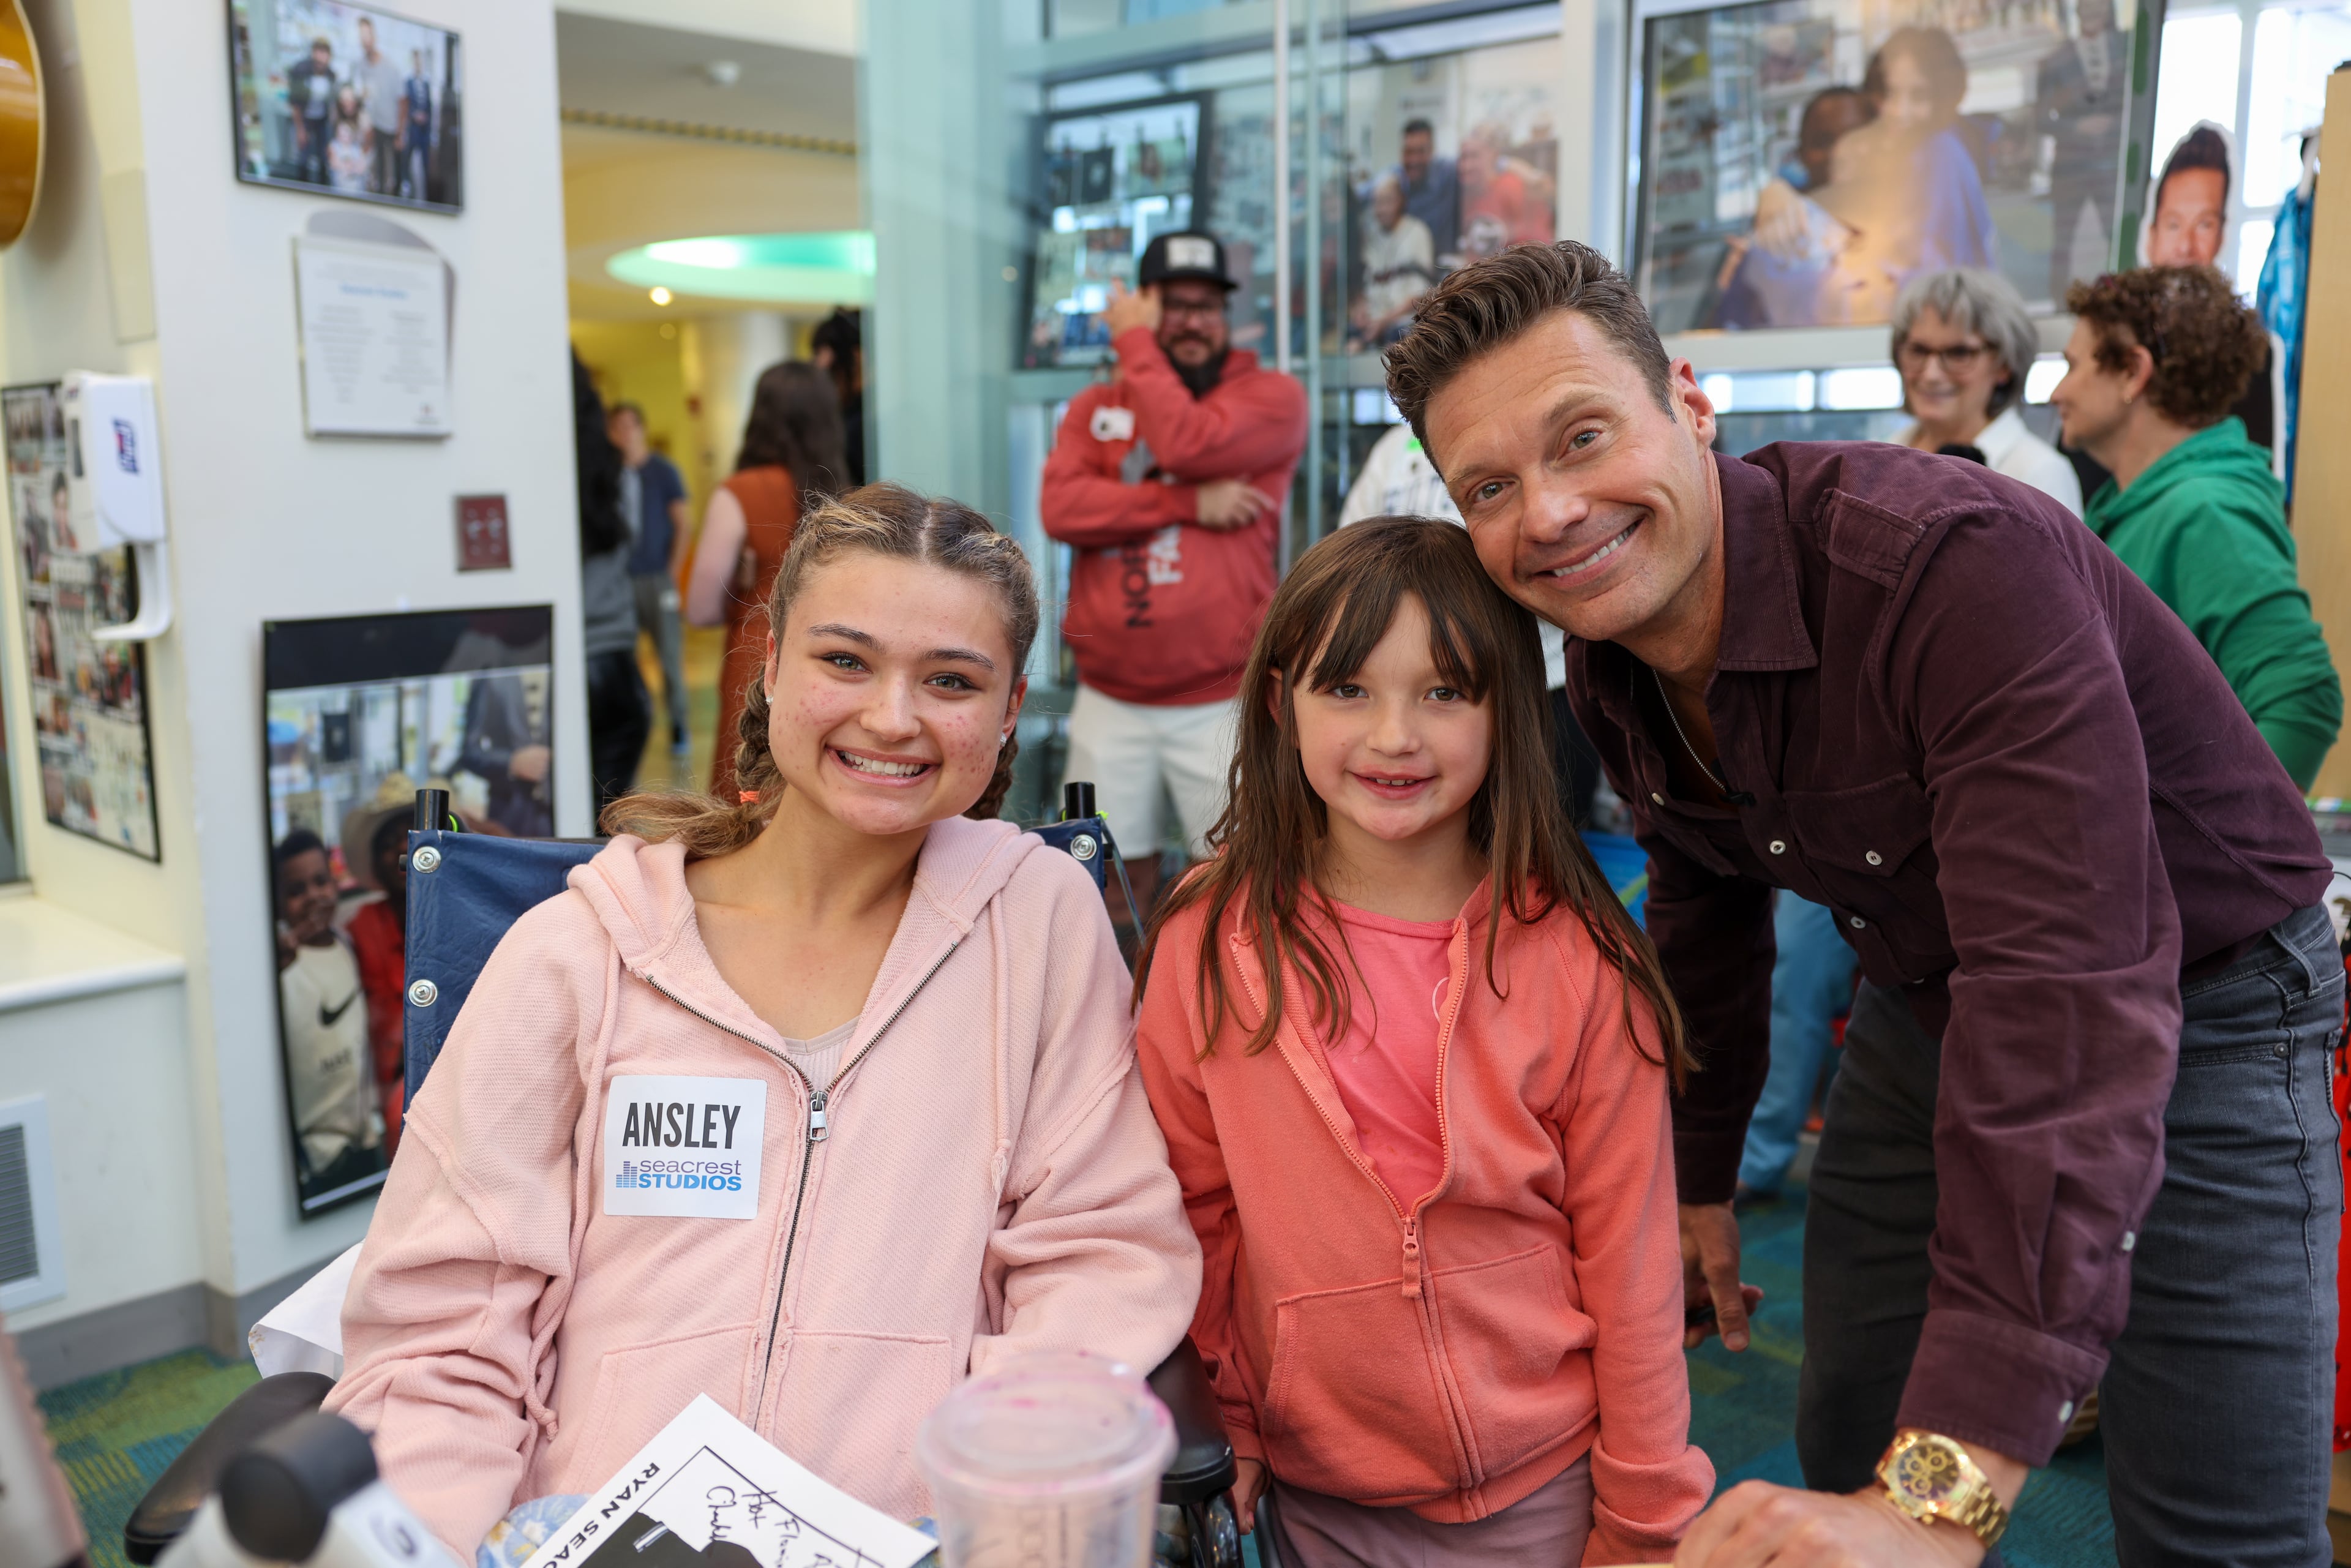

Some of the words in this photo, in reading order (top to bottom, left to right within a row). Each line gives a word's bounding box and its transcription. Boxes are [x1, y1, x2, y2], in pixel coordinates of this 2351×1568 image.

[622, 1103, 741, 1149] ANSLEY
[638, 1173, 742, 1191] STUDIOS
[639, 1160, 742, 1176] seacrest
[600, 1462, 661, 1520] RYAN
